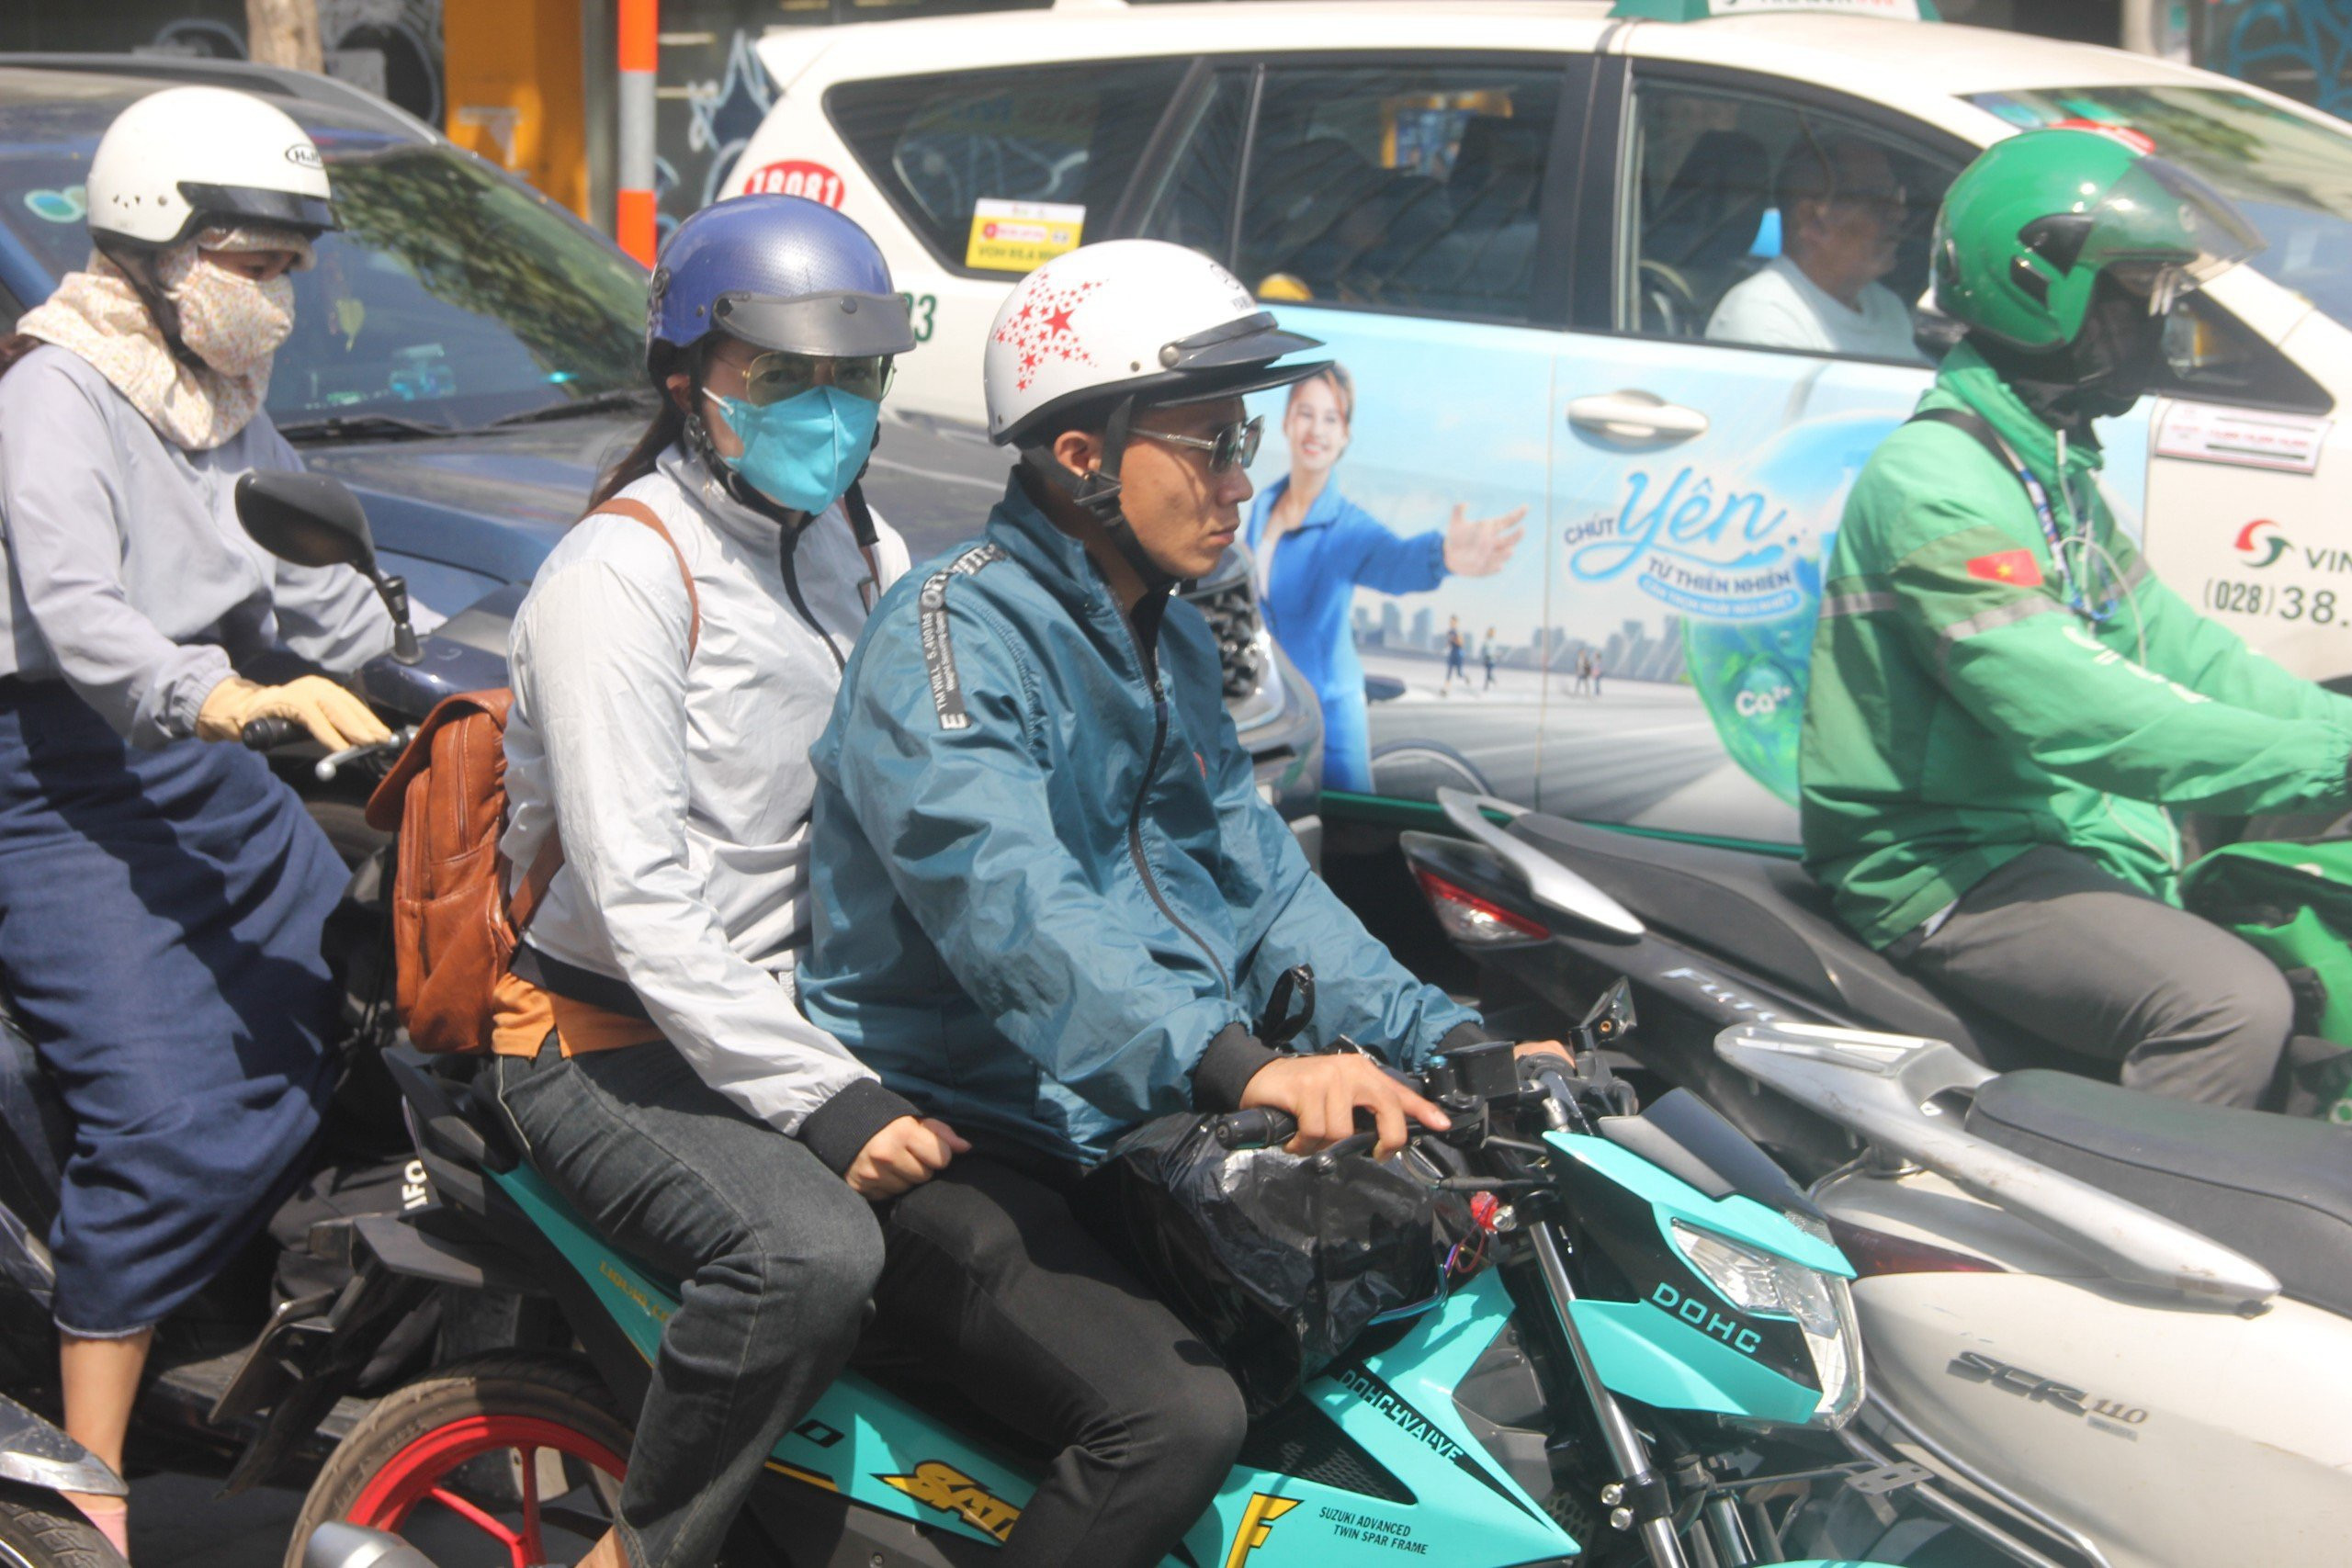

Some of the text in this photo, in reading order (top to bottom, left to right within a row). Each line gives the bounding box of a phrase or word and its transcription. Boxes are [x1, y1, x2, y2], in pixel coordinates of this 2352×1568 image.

[1569, 466, 1787, 582] Yên
[1652, 1281, 1762, 1353] DOHC
[2091, 1398, 2150, 1425] 110
[1318, 1506, 1411, 1537] SUZUKI ADVANCED
[1333, 1524, 1430, 1554] TWIN SPAR FRAME
